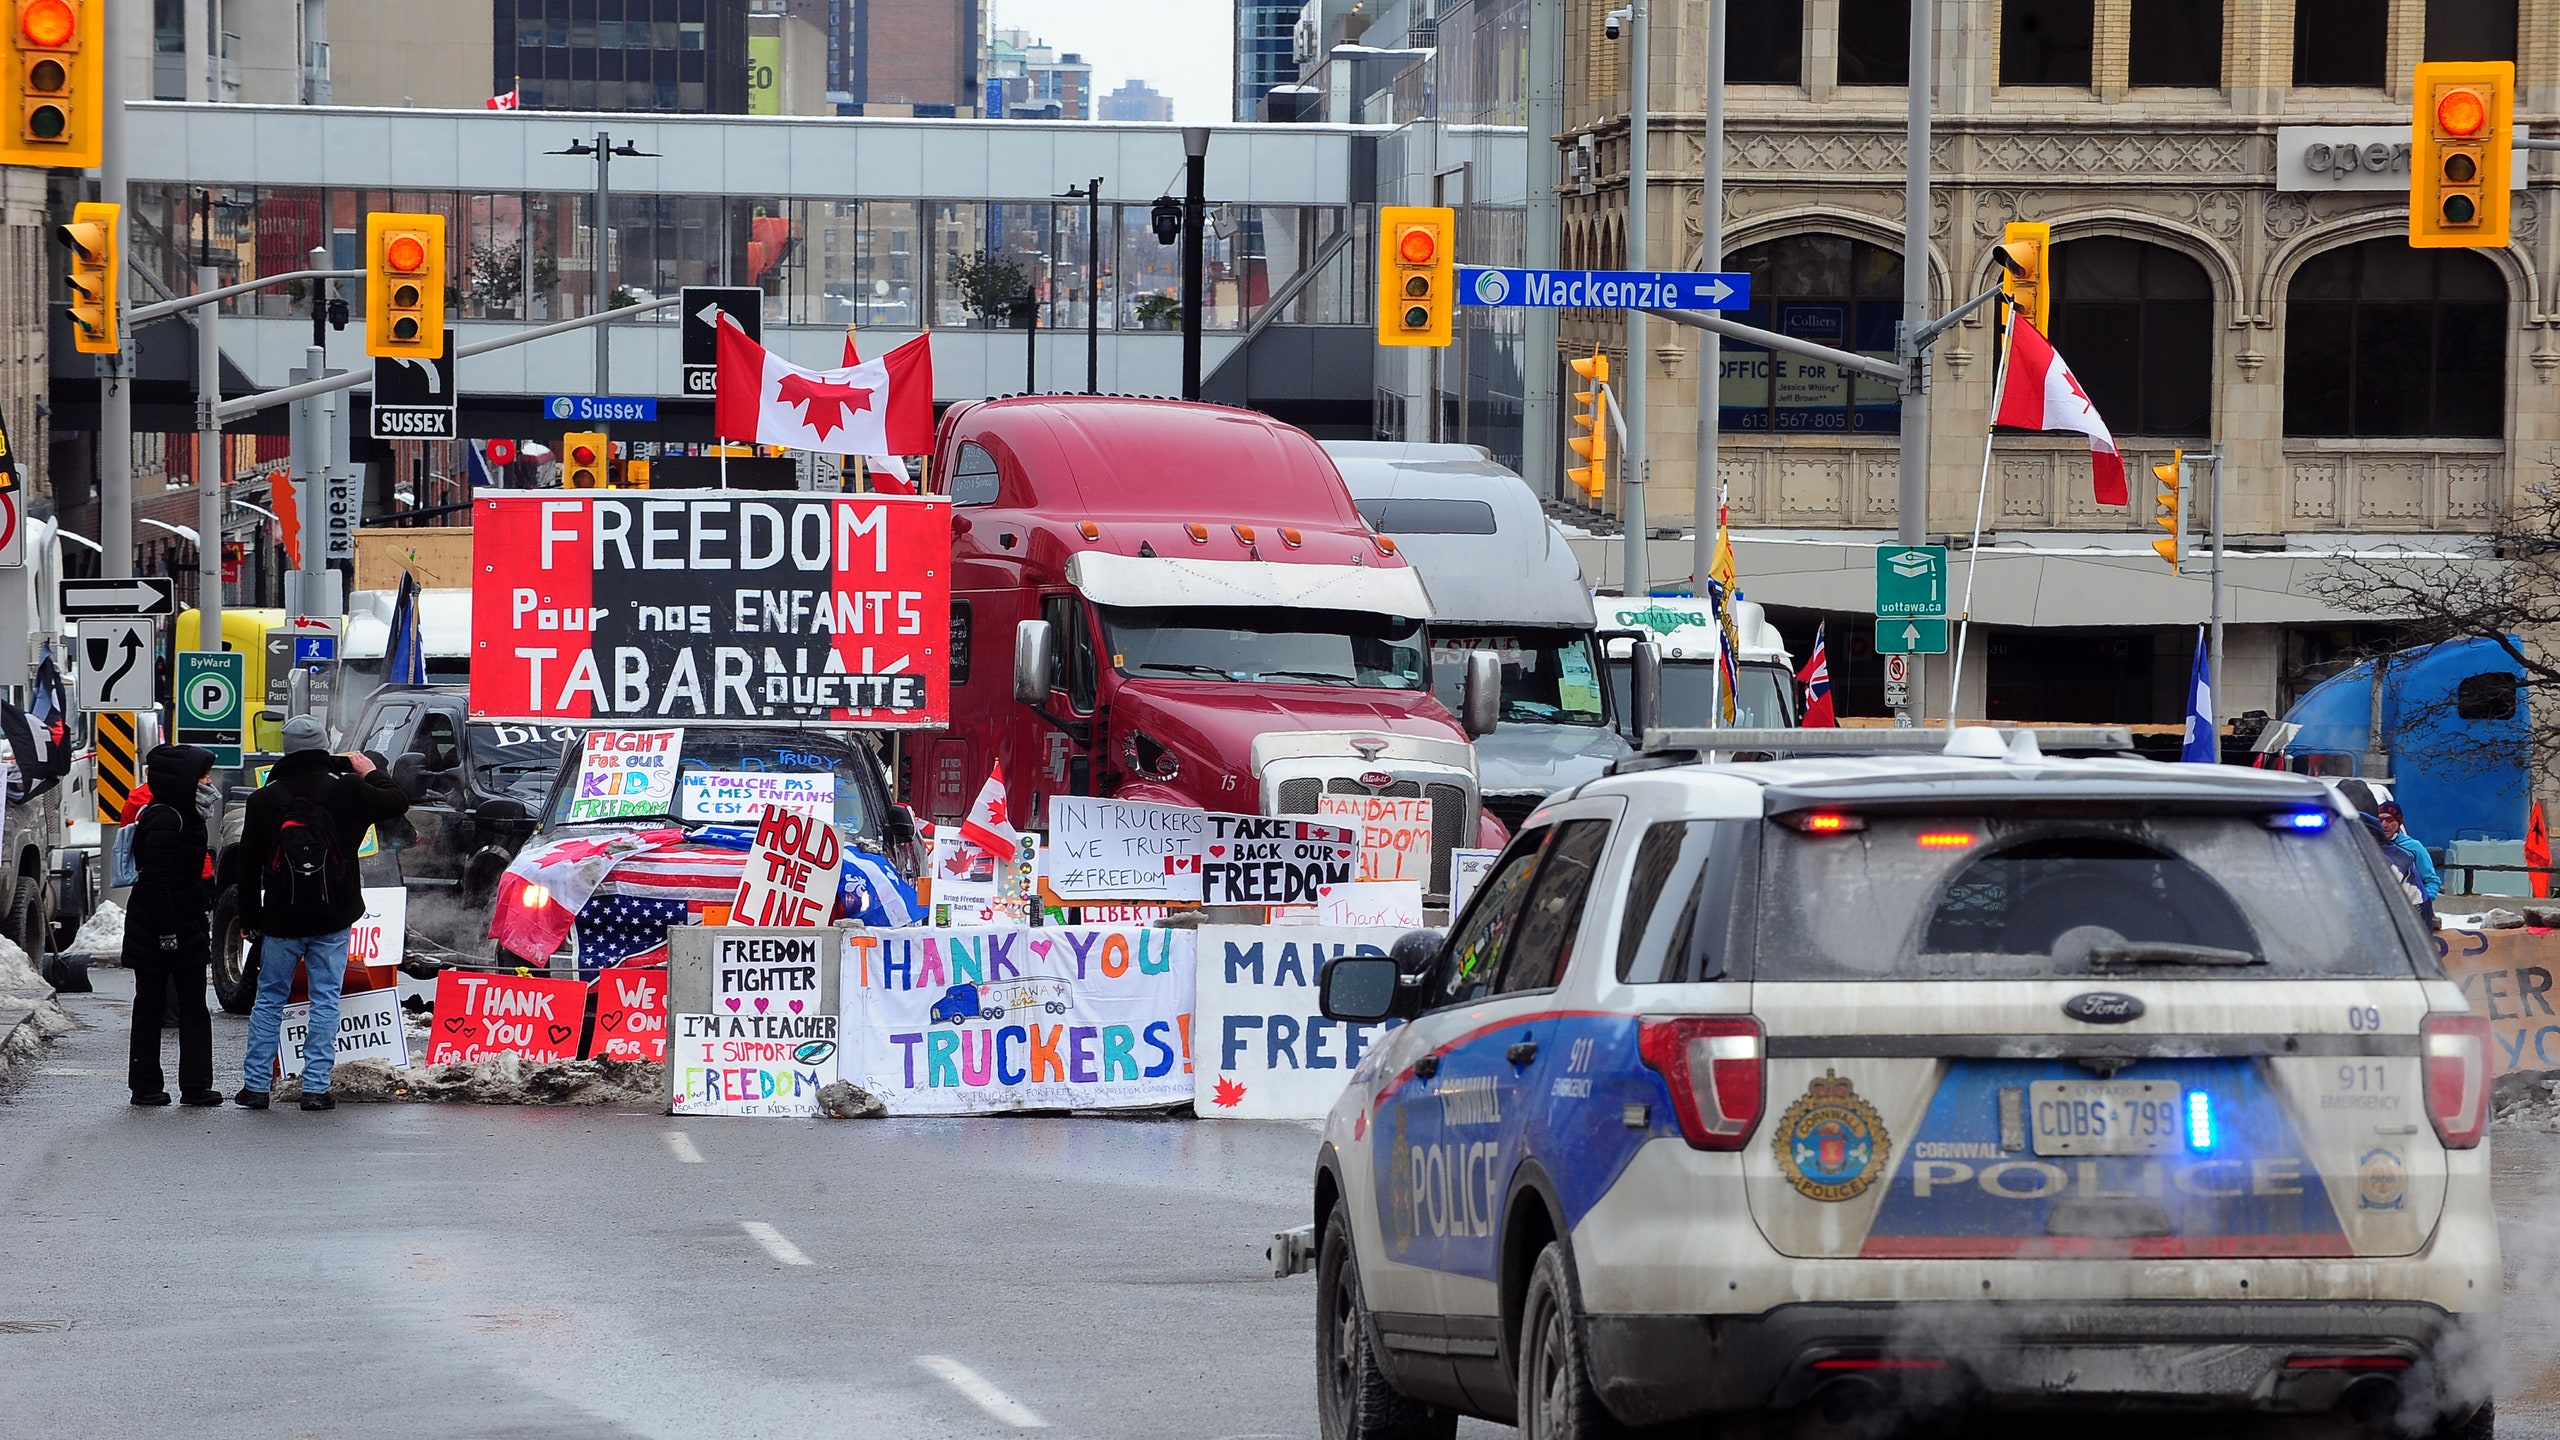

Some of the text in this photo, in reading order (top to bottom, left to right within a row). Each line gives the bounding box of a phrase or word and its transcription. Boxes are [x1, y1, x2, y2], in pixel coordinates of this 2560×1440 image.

[1525, 272, 1678, 308] Mackenzie
[1791, 314, 1837, 328] Colliers
[1799, 365, 1826, 378] FOR
[580, 398, 644, 419] Sussex
[1778, 394, 1793, 402] Jeff
[381, 412, 446, 433] SUSSEX
[540, 500, 888, 573] FREEDOM
[512, 587, 923, 636] Pour nos ENFANTS
[1881, 602, 1942, 613] uottawa.ca
[190, 656, 231, 669] ByWard
[310, 679, 329, 689] Park
[202, 685, 222, 710] P
[586, 731, 675, 753] FIGHT
[588, 754, 621, 768] FOR
[626, 754, 665, 768] OUR
[581, 769, 674, 799] KIDS
[684, 775, 814, 790] NE TOUCHE PAS
[718, 788, 753, 798] MES
[1220, 774, 1237, 791] 15
[571, 798, 669, 819] FREEDOM
[1060, 802, 1202, 834] IN TRUCKERS
[1318, 799, 1431, 822] MANDATE
[755, 803, 839, 871] HOLD
[1207, 816, 1291, 840] TAKE
[1361, 826, 1432, 853] EDOM
[1064, 837, 1192, 859] WE TRUST
[1233, 843, 1336, 862] BACK OUR
[762, 851, 812, 894] THE
[1059, 868, 1166, 889] #FREEDOM
[1202, 861, 1351, 904] FREEDOM
[732, 880, 824, 927] LINE
[1328, 899, 1422, 927] Thank You
[722, 938, 816, 963] FREEDOM
[849, 927, 1172, 991] THANK YOU
[1223, 941, 1390, 987] MAN
[722, 966, 816, 993] FIGHTER
[457, 978, 555, 1021] THANK
[615, 976, 657, 1010] WE
[992, 984, 1050, 1003] OTTAWA
[2081, 994, 2129, 1016] Ford
[286, 1013, 371, 1042] FROM
[374, 1010, 393, 1026] IS
[481, 1017, 534, 1046] YOU
[683, 1015, 838, 1039] I'M A TEACHER
[2348, 1006, 2381, 1032] 09
[294, 1030, 392, 1060] ENTIAL
[433, 1041, 462, 1065] FOR
[605, 1037, 640, 1056] FOR
[701, 1041, 798, 1063] I SUPPORT
[889, 1012, 1193, 1089] TRUCKERS!
[1220, 1014, 1404, 1071] FREE
[1567, 1036, 1595, 1073] 911
[2493, 1024, 2560, 1070] YO
[685, 1067, 821, 1102] FREEDOM
[2337, 1064, 2386, 1092] 911
[672, 1093, 686, 1107] NO
[740, 1100, 822, 1115] LET KIDS PLAY
[2320, 1094, 2402, 1111] EMERGENCY
[1800, 1108, 1863, 1134] CORNWALL
[2038, 1100, 2176, 1137] CDBS 799
[1410, 1141, 1500, 1238] POLICE
[1801, 1177, 1863, 1199] POLICE
[1912, 1157, 2304, 1199] POLICE
